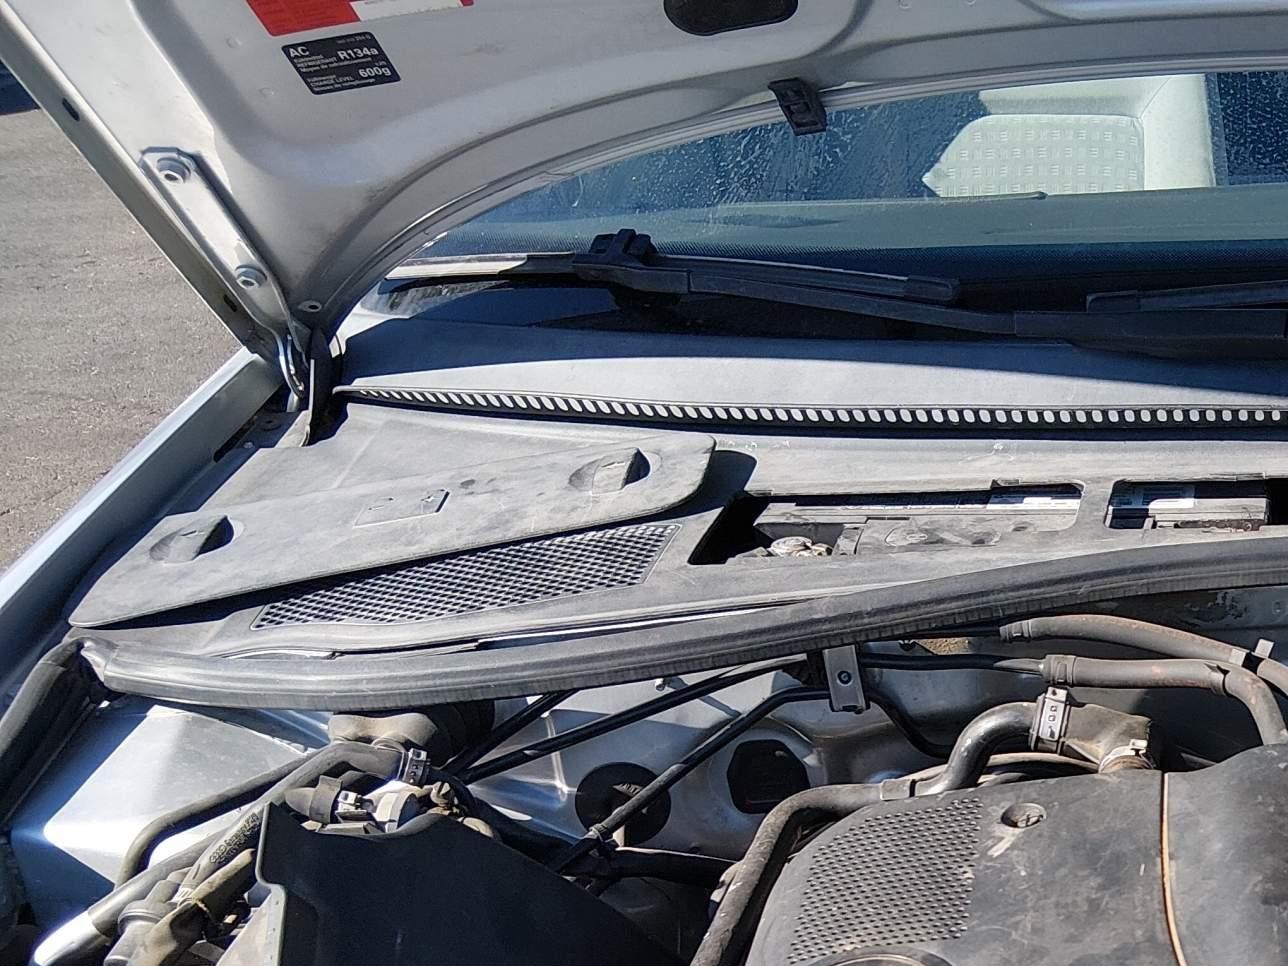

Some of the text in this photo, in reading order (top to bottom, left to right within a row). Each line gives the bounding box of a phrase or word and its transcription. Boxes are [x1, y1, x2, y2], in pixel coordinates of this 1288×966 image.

[289, 46, 310, 58] AC
[337, 47, 379, 60] R134a
[358, 66, 392, 79] 600g
